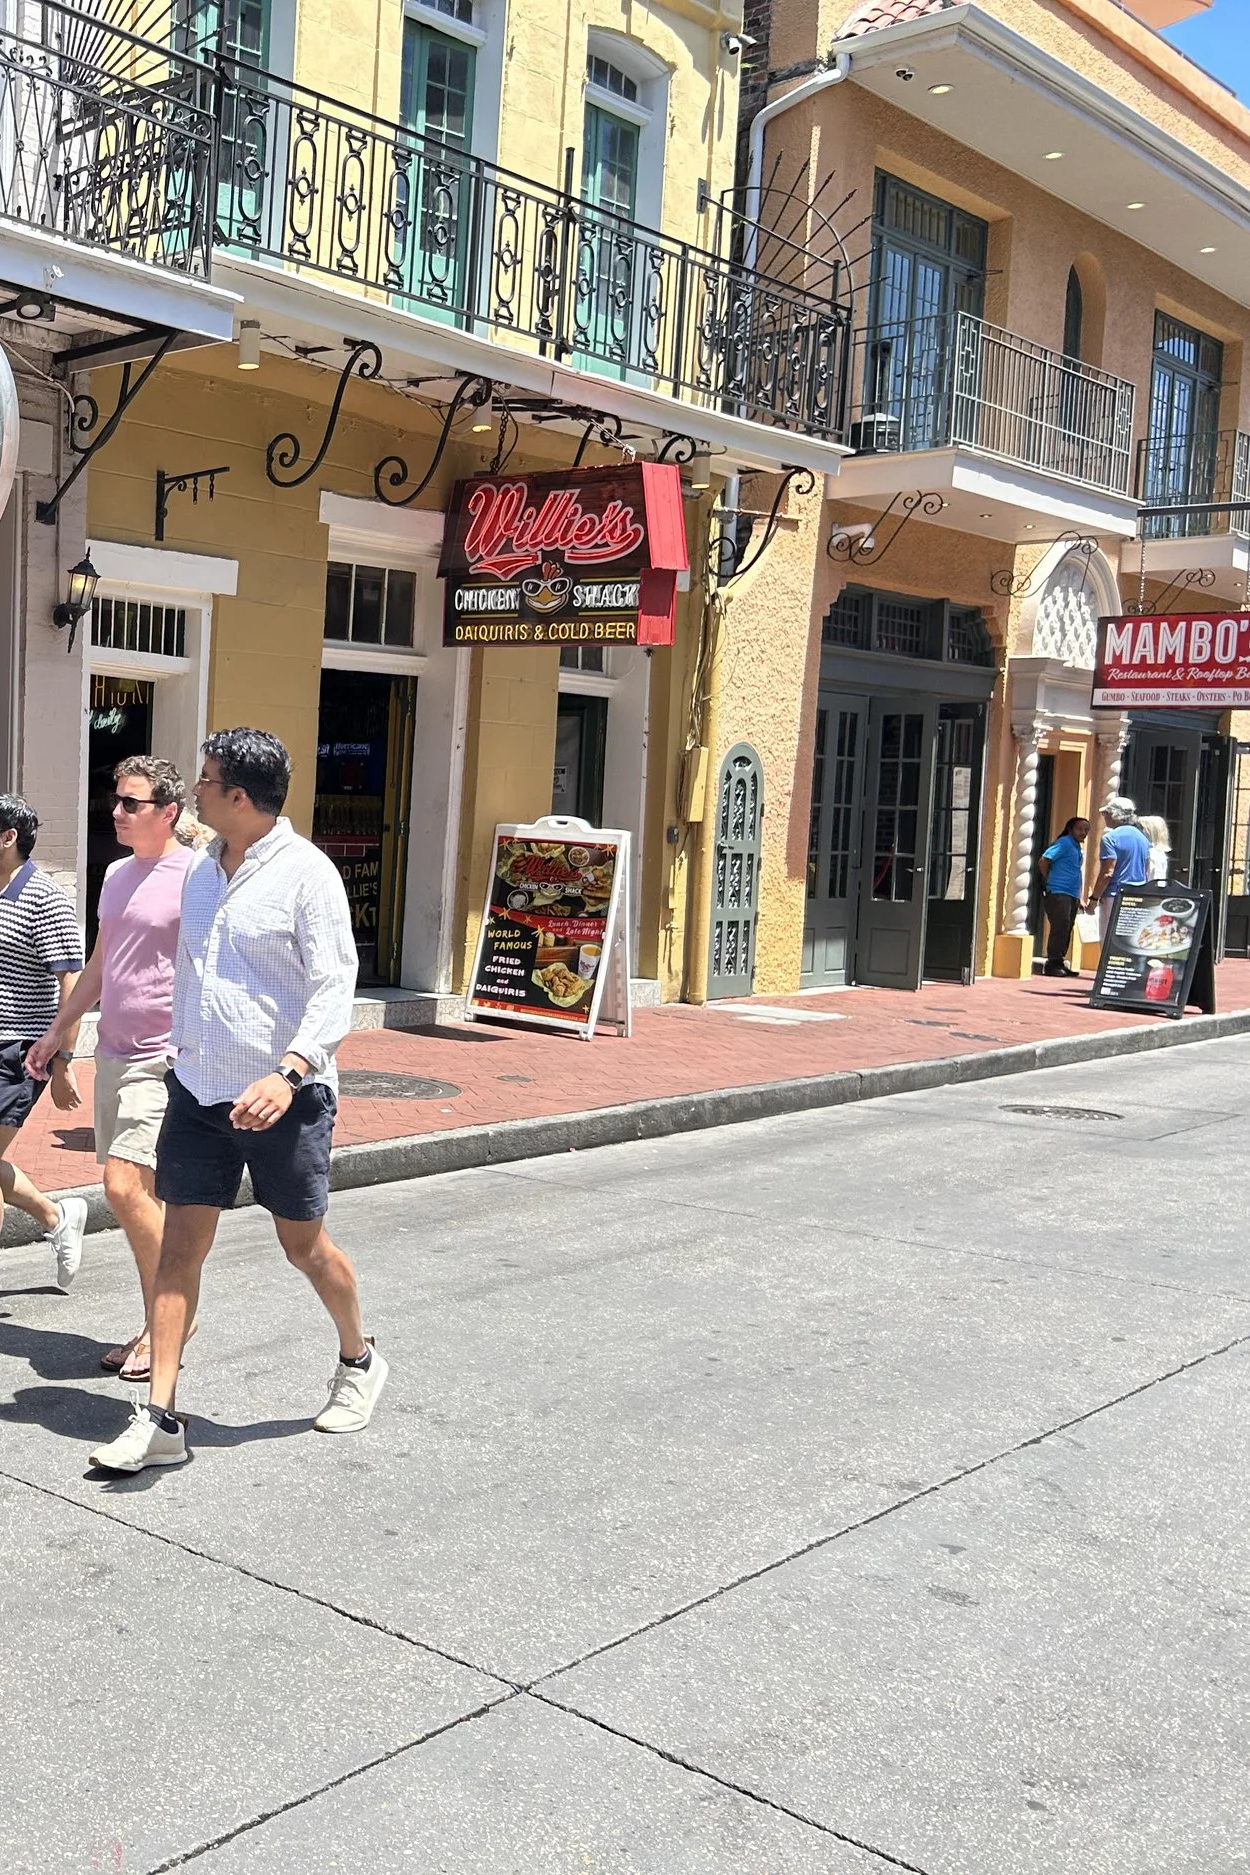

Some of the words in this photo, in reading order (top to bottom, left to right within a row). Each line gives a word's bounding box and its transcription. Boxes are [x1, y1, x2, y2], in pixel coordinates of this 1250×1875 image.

[464, 481, 638, 567] Willie's
[454, 588, 521, 612] CHICKEN
[572, 584, 640, 608] SHACK
[456, 624, 529, 642] DAIQUIRIS
[534, 626, 544, 640] &
[549, 623, 589, 640] COLD
[594, 622, 636, 639] BEER
[1104, 619, 1250, 665] MAMBO'
[1108, 668, 1172, 680] Restaurant
[1172, 667, 1184, 680] &
[1186, 667, 1234, 682] Rooftop
[1102, 691, 1125, 701] GUMBO
[1130, 691, 1160, 701] SEAFOOD
[1166, 690, 1191, 701] STEAKS
[1196, 690, 1226, 701] OYSTERS
[488, 930, 520, 938] WORLD
[494, 941, 533, 950] FAMOUS
[492, 956, 521, 965] FRIED
[484, 965, 525, 976] CHICKEN
[476, 984, 526, 997] DAIQUIRIS
